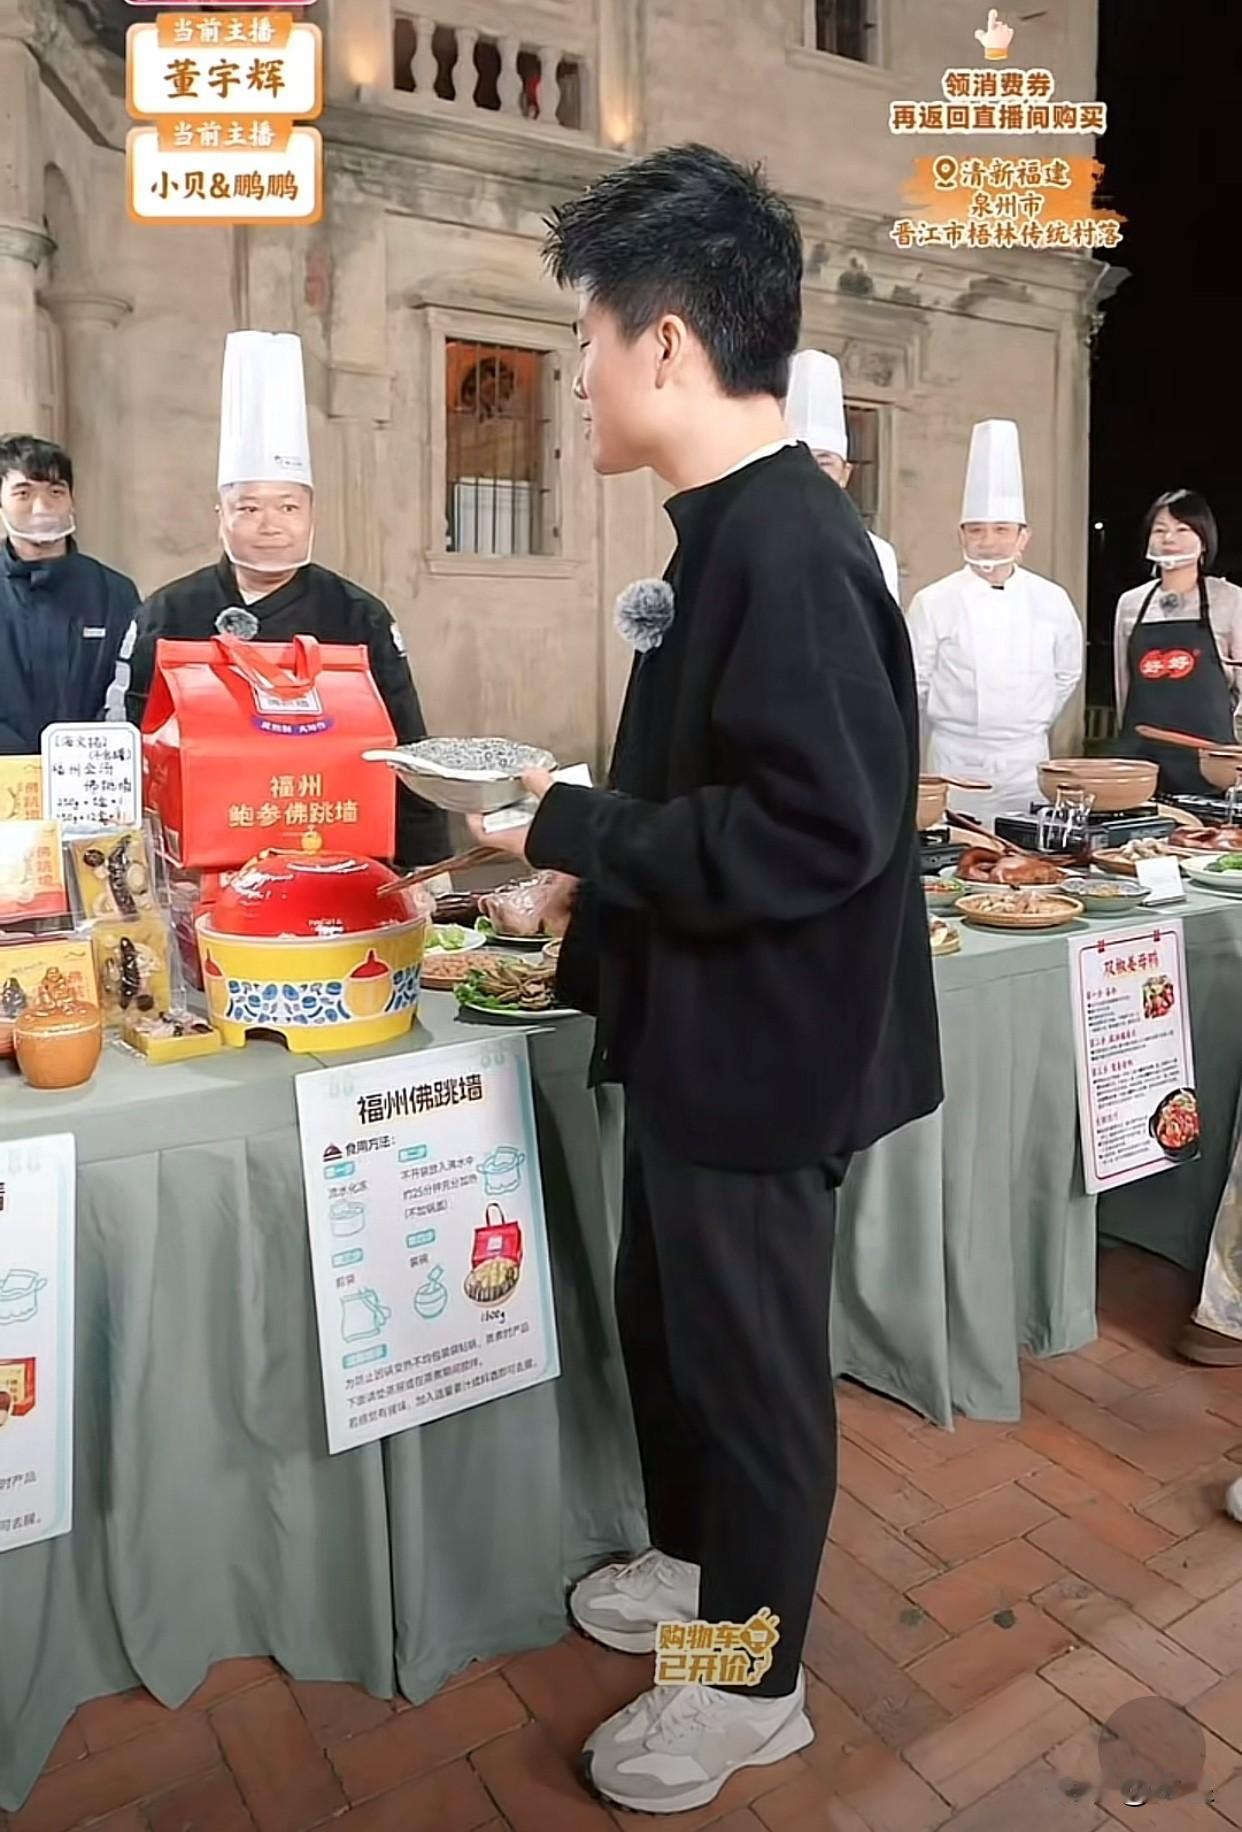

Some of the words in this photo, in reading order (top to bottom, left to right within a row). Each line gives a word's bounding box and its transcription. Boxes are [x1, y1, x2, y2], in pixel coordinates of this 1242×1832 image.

[270, 773, 323, 798] 福州
[228, 800, 358, 828] 鲍参佛跳墙
[357, 1074, 483, 1125] 福州佛跳墙
